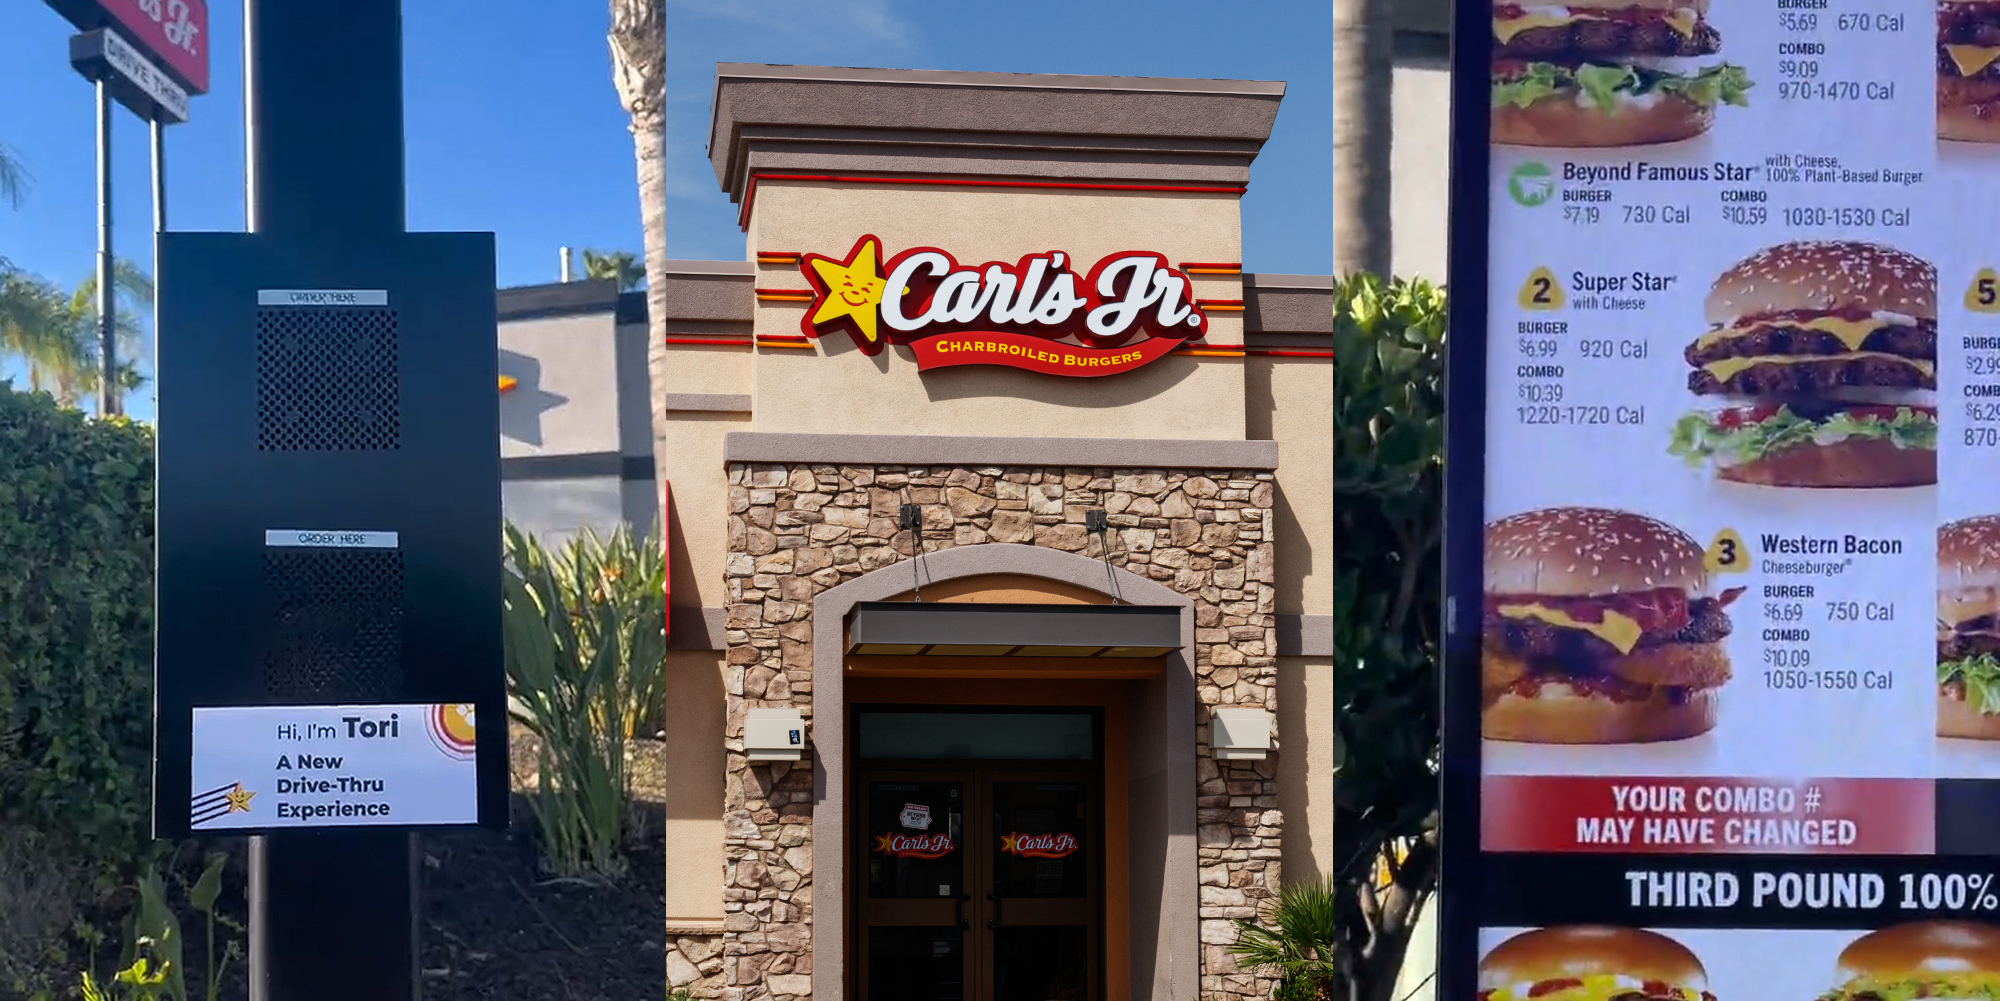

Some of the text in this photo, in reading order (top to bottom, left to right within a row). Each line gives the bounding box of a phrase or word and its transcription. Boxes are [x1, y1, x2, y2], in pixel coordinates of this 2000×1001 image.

[1779, 13, 1905, 32] $5.69 670 Cal
[1778, 43, 1825, 55] COMBO
[1778, 60, 1819, 78] $9.09
[1778, 81, 1895, 100] 970-1470 Cal
[1765, 155, 1791, 167] with
[1563, 162, 1632, 185] Beyond
[1636, 162, 1709, 181] Famous
[1766, 170, 1924, 185] 100% Plant-Based Burger
[1562, 190, 1612, 202] BURGER
[1720, 190, 1768, 202] COMBO
[1622, 206, 1656, 224] 730
[1662, 206, 1690, 224] Cal
[1722, 206, 1910, 226] $10.59 1030-1530 Cal
[880, 251, 1088, 331] Carl's
[1533, 277, 1551, 303] 2
[1572, 271, 1627, 294] Super
[1978, 279, 1995, 304] 5
[1573, 296, 1646, 310] with Cheese
[1518, 322, 1568, 334] BURGER
[1519, 339, 1648, 359] $6.99 920 Cal
[1517, 365, 1565, 378] COMBO
[1518, 384, 1564, 402] $10.39
[1517, 405, 1644, 425] 1220-1720 Cal
[298, 533, 365, 544] ORDER HERE
[1761, 534, 1902, 554] Western Bacon
[1717, 538, 1736, 565] 3
[1763, 585, 1814, 598] BURGER
[1764, 602, 1894, 621] $6.69 750 Cal
[1762, 629, 1810, 641] COMBO
[1764, 649, 1810, 667] $10.09
[1764, 671, 1892, 689] 1050-1550 Cal
[278, 723, 302, 741] Hi,
[342, 713, 398, 738] Tori
[276, 754, 343, 770] A New
[277, 776, 384, 793] Drive-Thru
[1611, 785, 1822, 812] YOUR COMBO #
[277, 800, 390, 821] Experience
[1576, 817, 1857, 846] MAY HAVE CHANGED
[891, 835, 954, 851] Carl's Jr.
[1016, 835, 1077, 851] Carl's Jr.
[1625, 871, 1998, 910] THIRD POUND 100%
